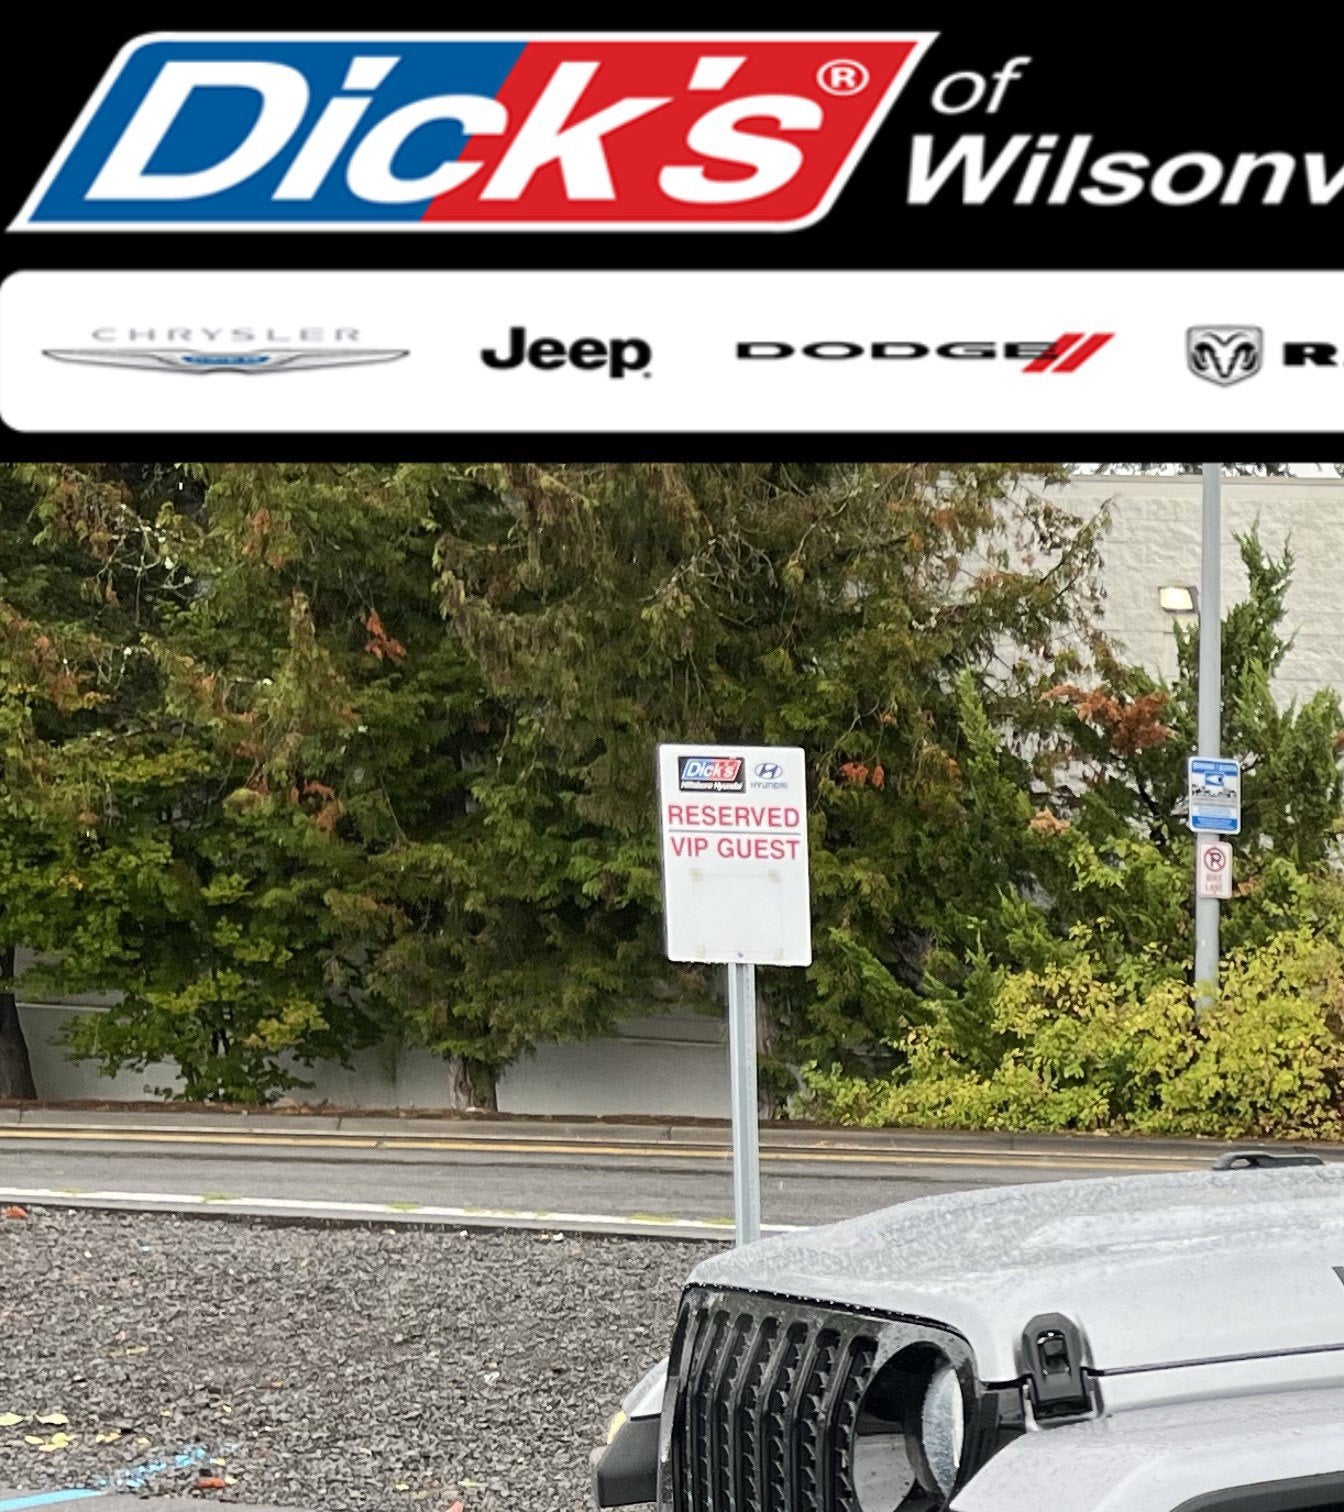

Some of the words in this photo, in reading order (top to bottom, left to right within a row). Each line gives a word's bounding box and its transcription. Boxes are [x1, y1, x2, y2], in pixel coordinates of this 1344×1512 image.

[668, 805, 800, 828] RESERVED
[670, 837, 709, 857] VIP
[717, 837, 800, 860] GUEST
